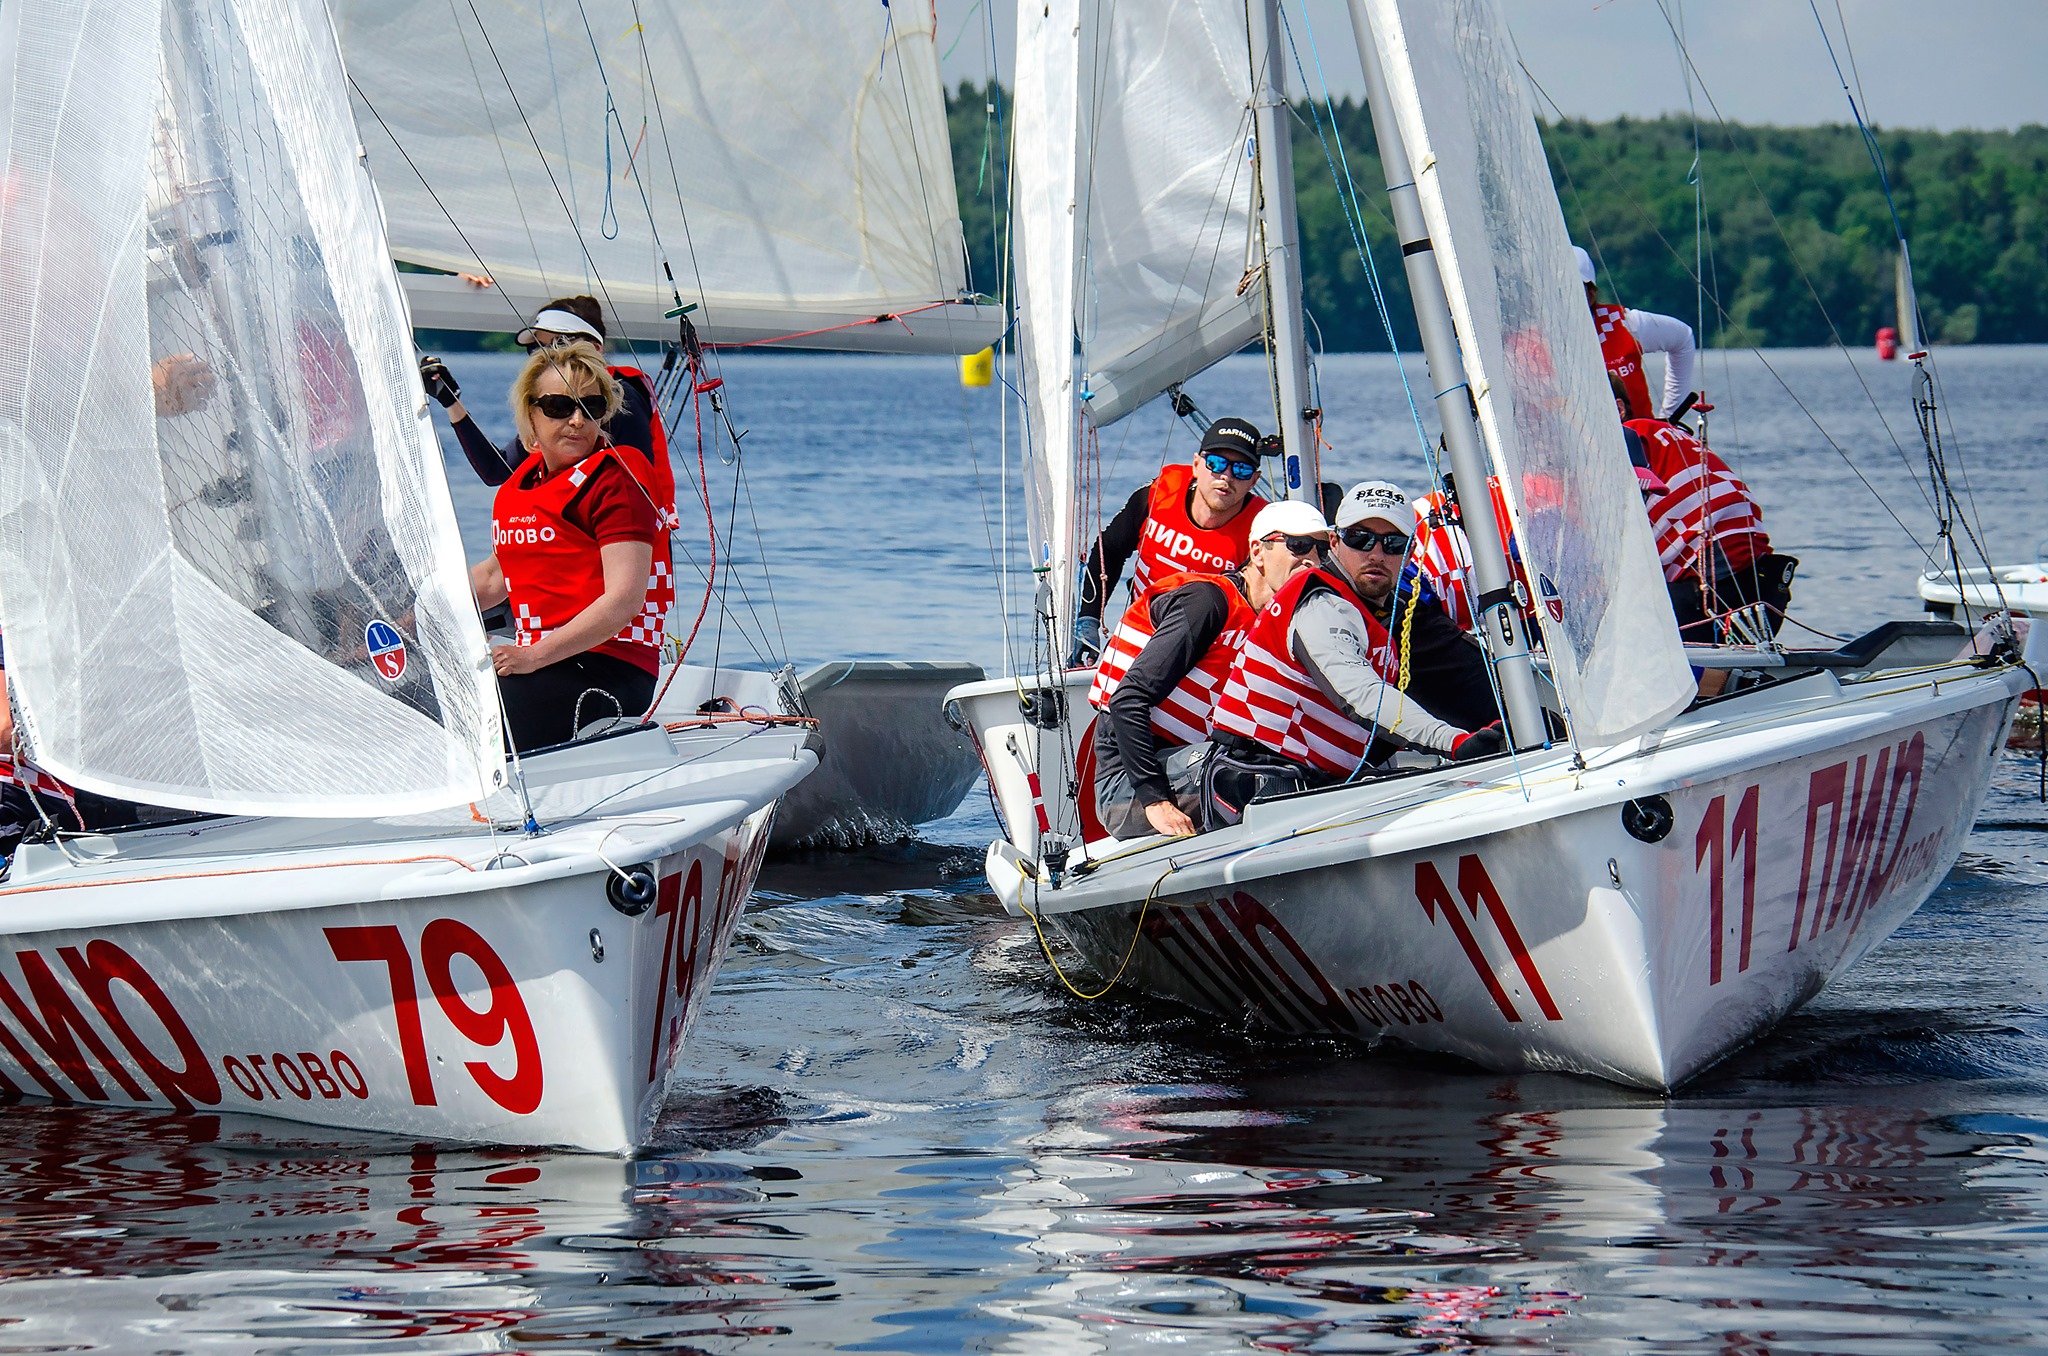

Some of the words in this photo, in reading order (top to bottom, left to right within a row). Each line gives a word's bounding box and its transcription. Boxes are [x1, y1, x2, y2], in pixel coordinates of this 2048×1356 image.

[1218, 428, 1255, 445] GARMIN
[1414, 854, 1564, 1023] 11
[1696, 784, 1760, 986] 11
[322, 918, 544, 1115] 79
